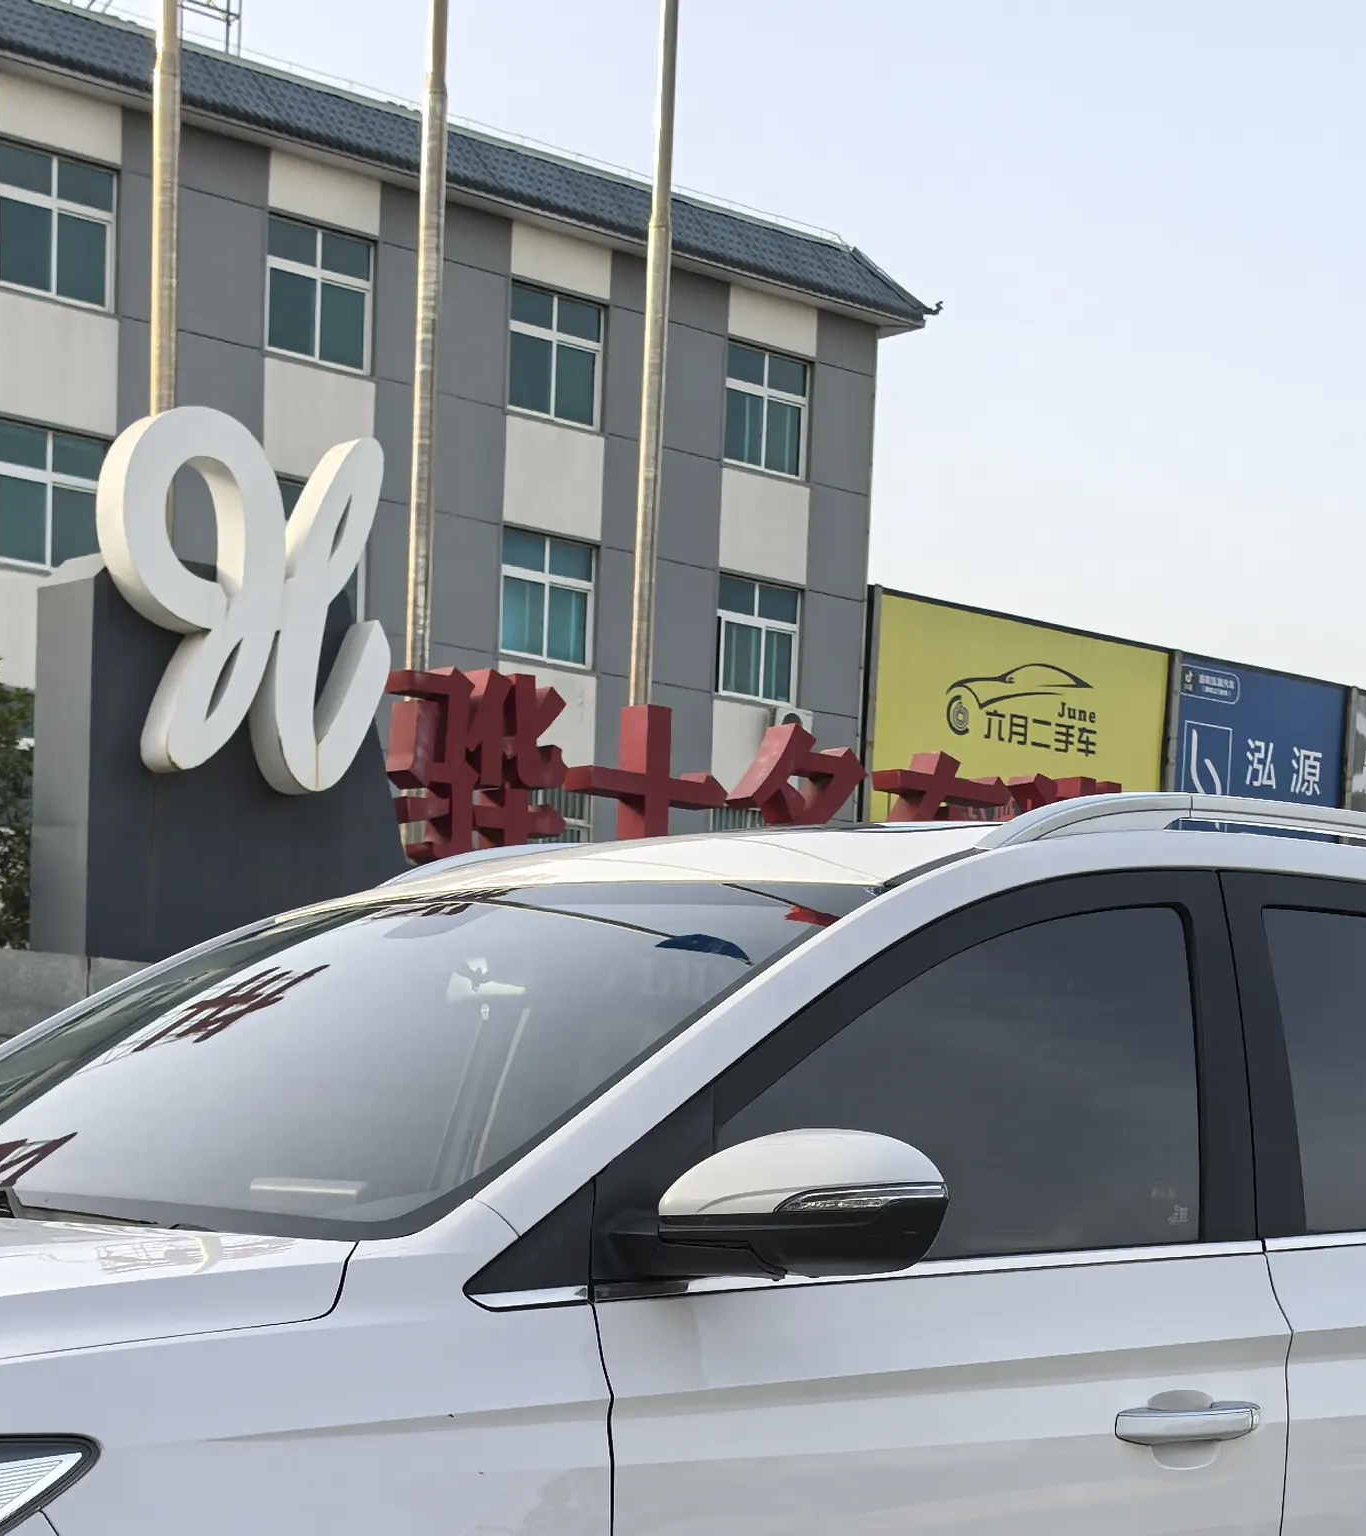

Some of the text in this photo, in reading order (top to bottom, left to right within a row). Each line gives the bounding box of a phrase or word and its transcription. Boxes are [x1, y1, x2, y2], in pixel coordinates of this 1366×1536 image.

[983, 709, 1098, 758] 六月二手车
[1057, 701, 1097, 725] June
[1244, 737, 1323, 797] 泓源
